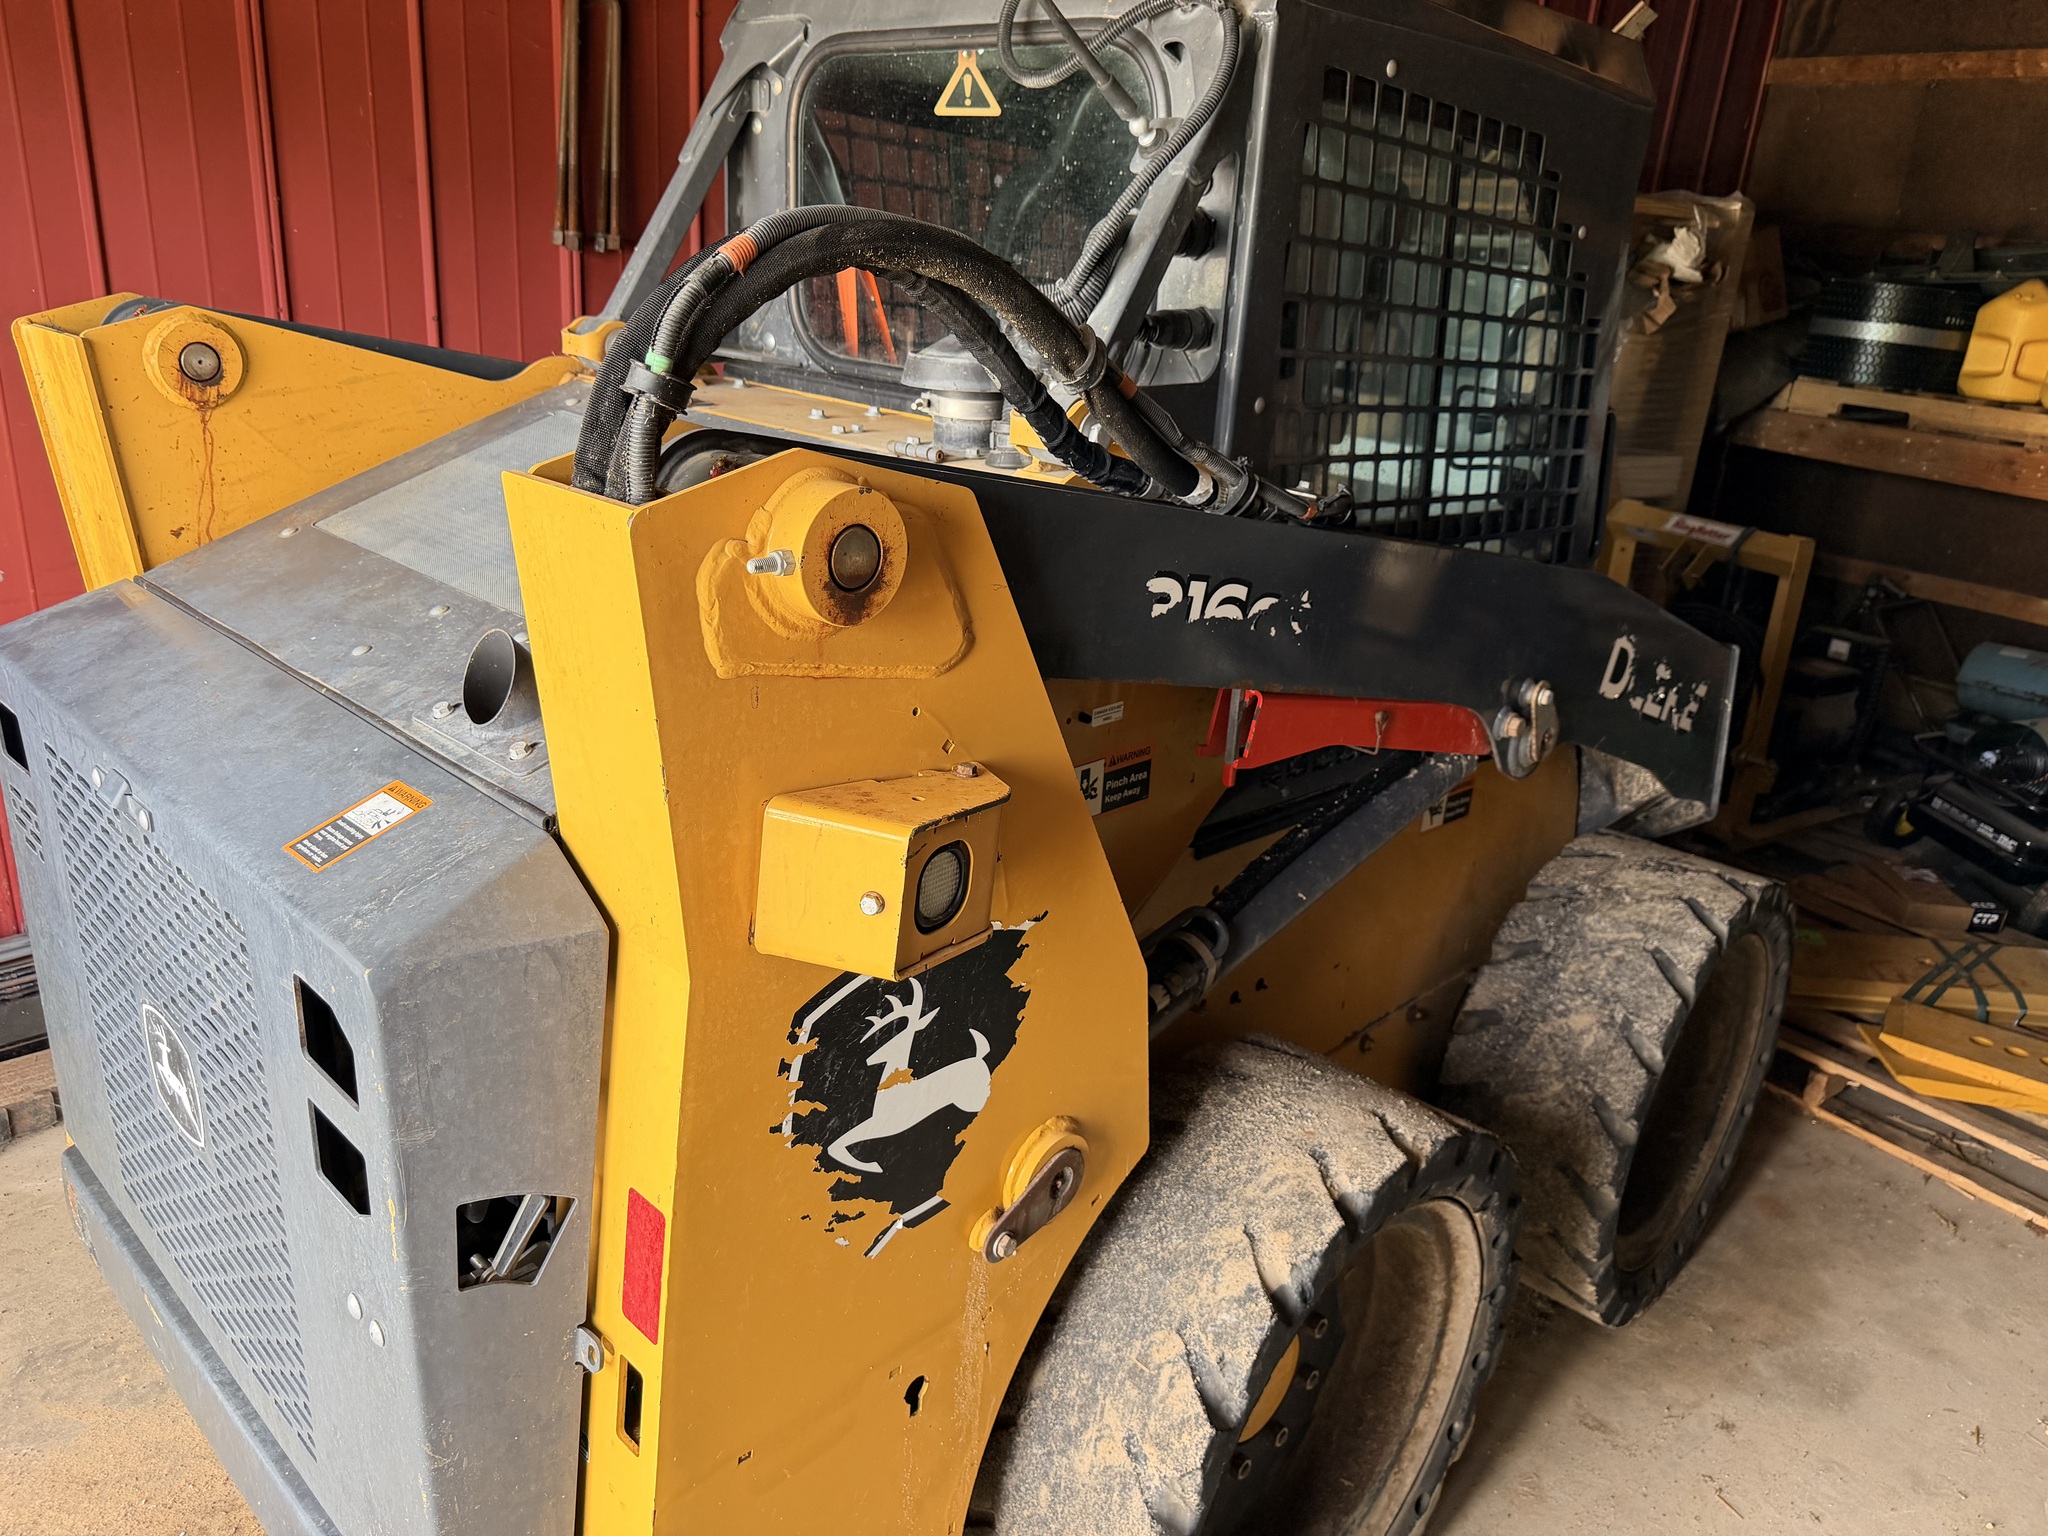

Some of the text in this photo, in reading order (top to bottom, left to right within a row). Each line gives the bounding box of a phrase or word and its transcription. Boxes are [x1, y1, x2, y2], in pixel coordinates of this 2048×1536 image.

[1116, 746, 1151, 764] WARNING
[1105, 770, 1148, 790] Pinch Area
[394, 786, 427, 809] WARNING
[1104, 785, 1142, 804] Keep Away
[1972, 912, 2001, 926] CTP
